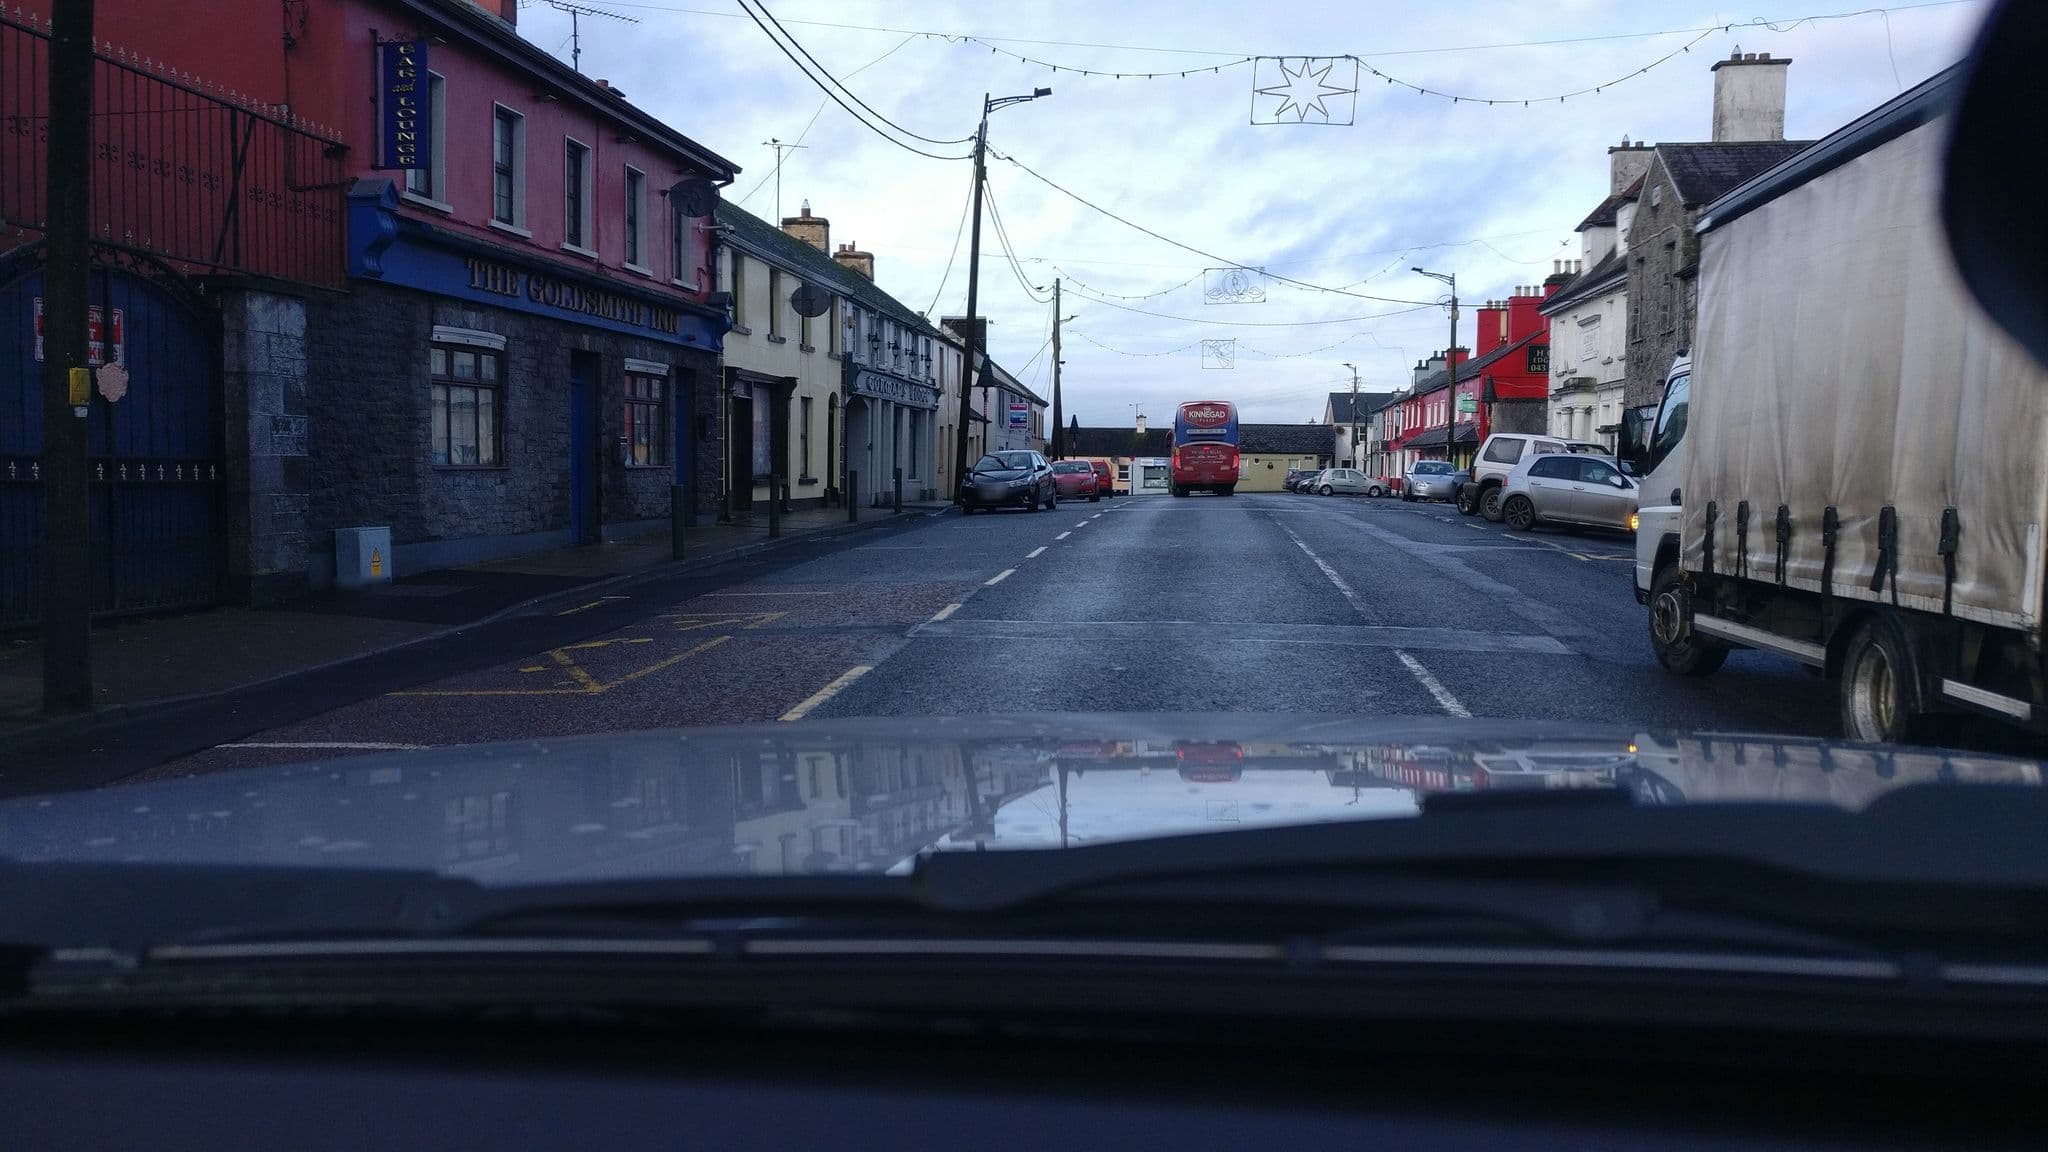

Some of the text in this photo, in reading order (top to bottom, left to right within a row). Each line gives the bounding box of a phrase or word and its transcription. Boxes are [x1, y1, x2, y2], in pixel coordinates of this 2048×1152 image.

[392, 44, 418, 165] BAR and LOUNGE
[469, 258, 680, 335] THE GOLDSMITH INN
[1530, 364, 1546, 372] 043
[1188, 410, 1226, 418] KINNEGAD
